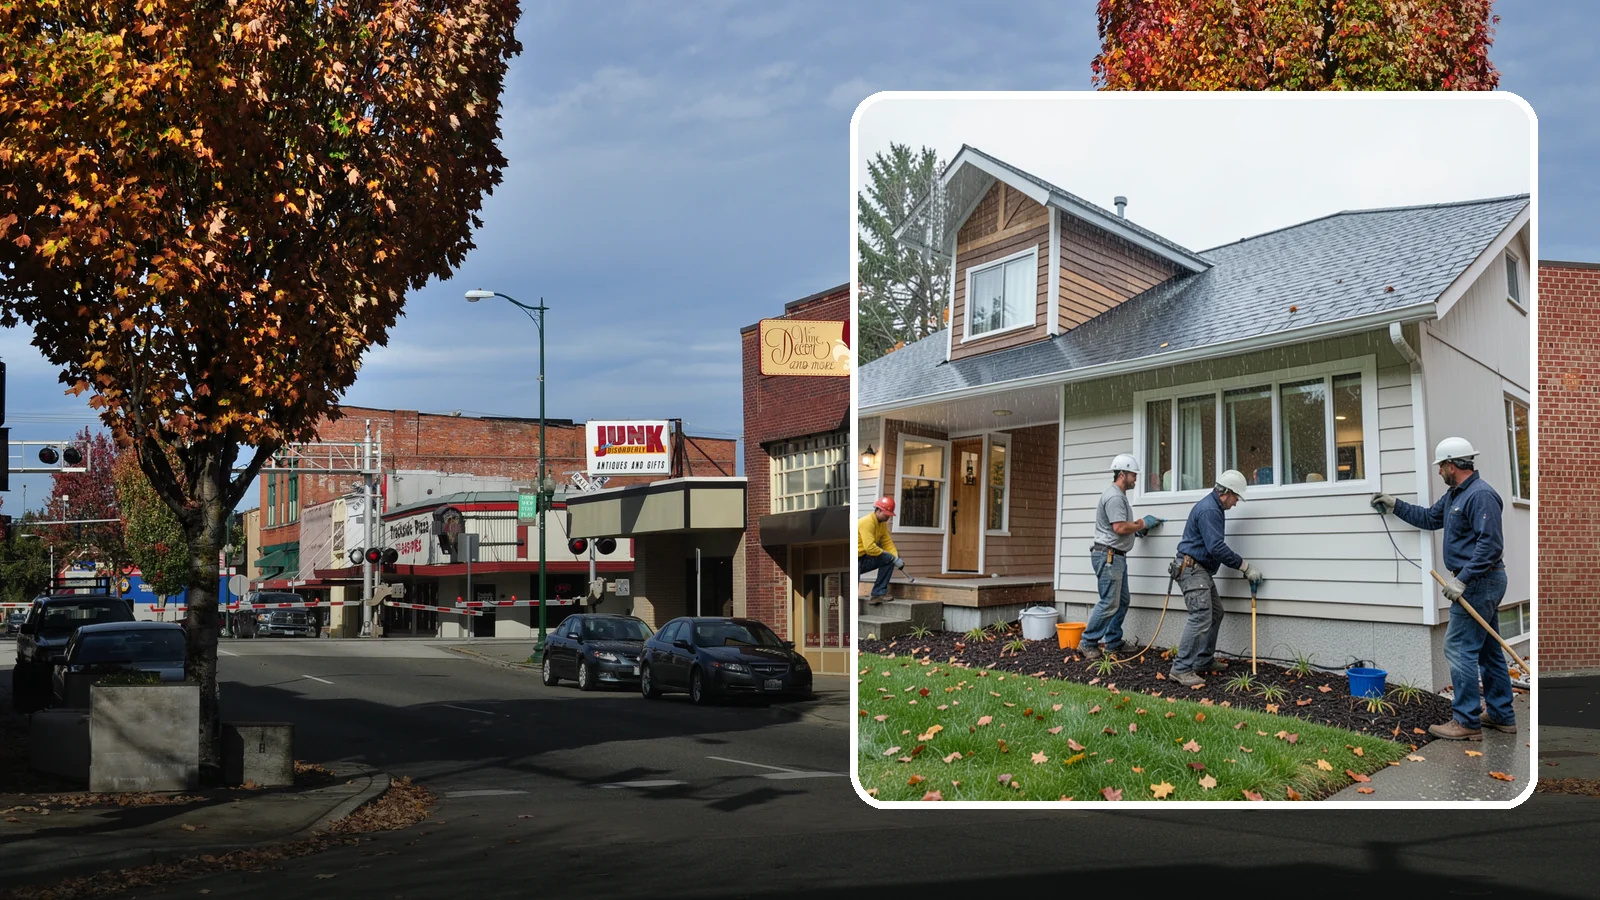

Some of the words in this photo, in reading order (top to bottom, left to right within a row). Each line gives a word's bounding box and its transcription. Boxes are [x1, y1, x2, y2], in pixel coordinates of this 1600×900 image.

[595, 425, 665, 457] JUNK
[607, 446, 646, 454] DISORDERLY
[597, 461, 628, 470] ANTIQUES
[631, 461, 643, 469] AND
[647, 461, 665, 469] GIFTS
[390, 521, 413, 539] Trackside
[414, 519, 429, 534] Pizza
